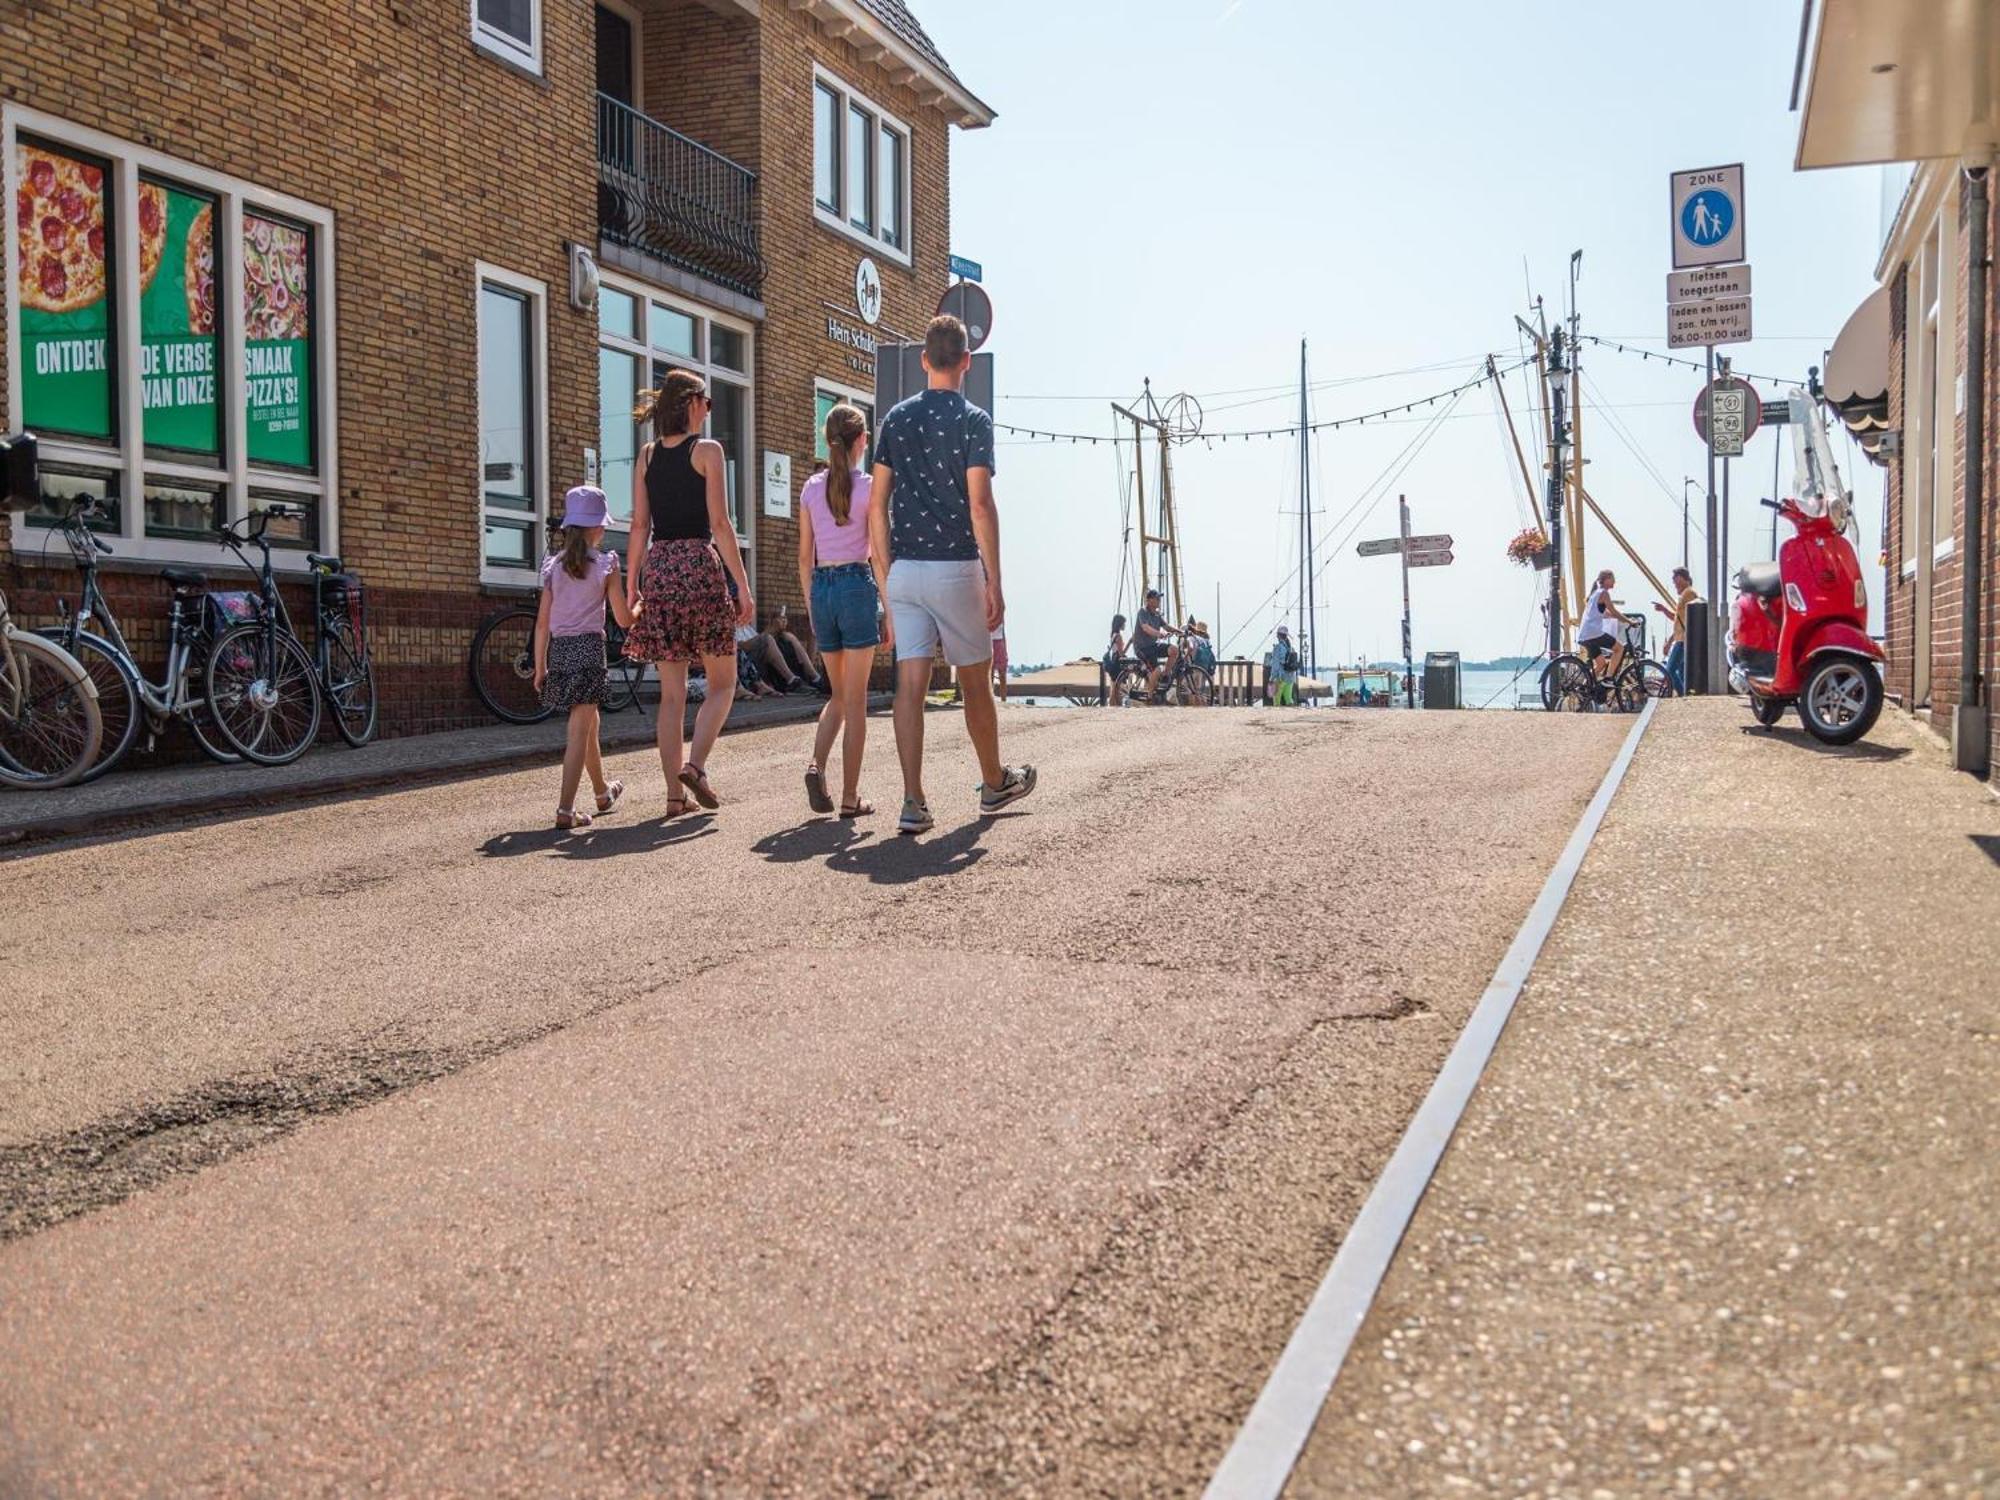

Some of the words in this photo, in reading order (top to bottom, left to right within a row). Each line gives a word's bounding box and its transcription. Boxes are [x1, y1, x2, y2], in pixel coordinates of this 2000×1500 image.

[1690, 172, 1725, 186] ZONE
[1690, 271, 1728, 283] fietsen
[1680, 283, 1739, 298] toegestaan
[1671, 307, 1698, 317] laden
[1701, 306, 1712, 315] en
[1716, 302, 1747, 313] lossen
[1701, 317, 1717, 328] t/m
[1671, 330, 1728, 344] 06.00-11.00
[1730, 329, 1747, 338] uur
[36, 339, 106, 375] ONTDEK
[140, 344, 160, 375] DE
[164, 342, 213, 374] VERSE
[244, 346, 293, 377] SMAAK
[141, 378, 173, 409] VAN
[177, 375, 214, 406] ONZE
[245, 377, 298, 408] PIZZA'S!
